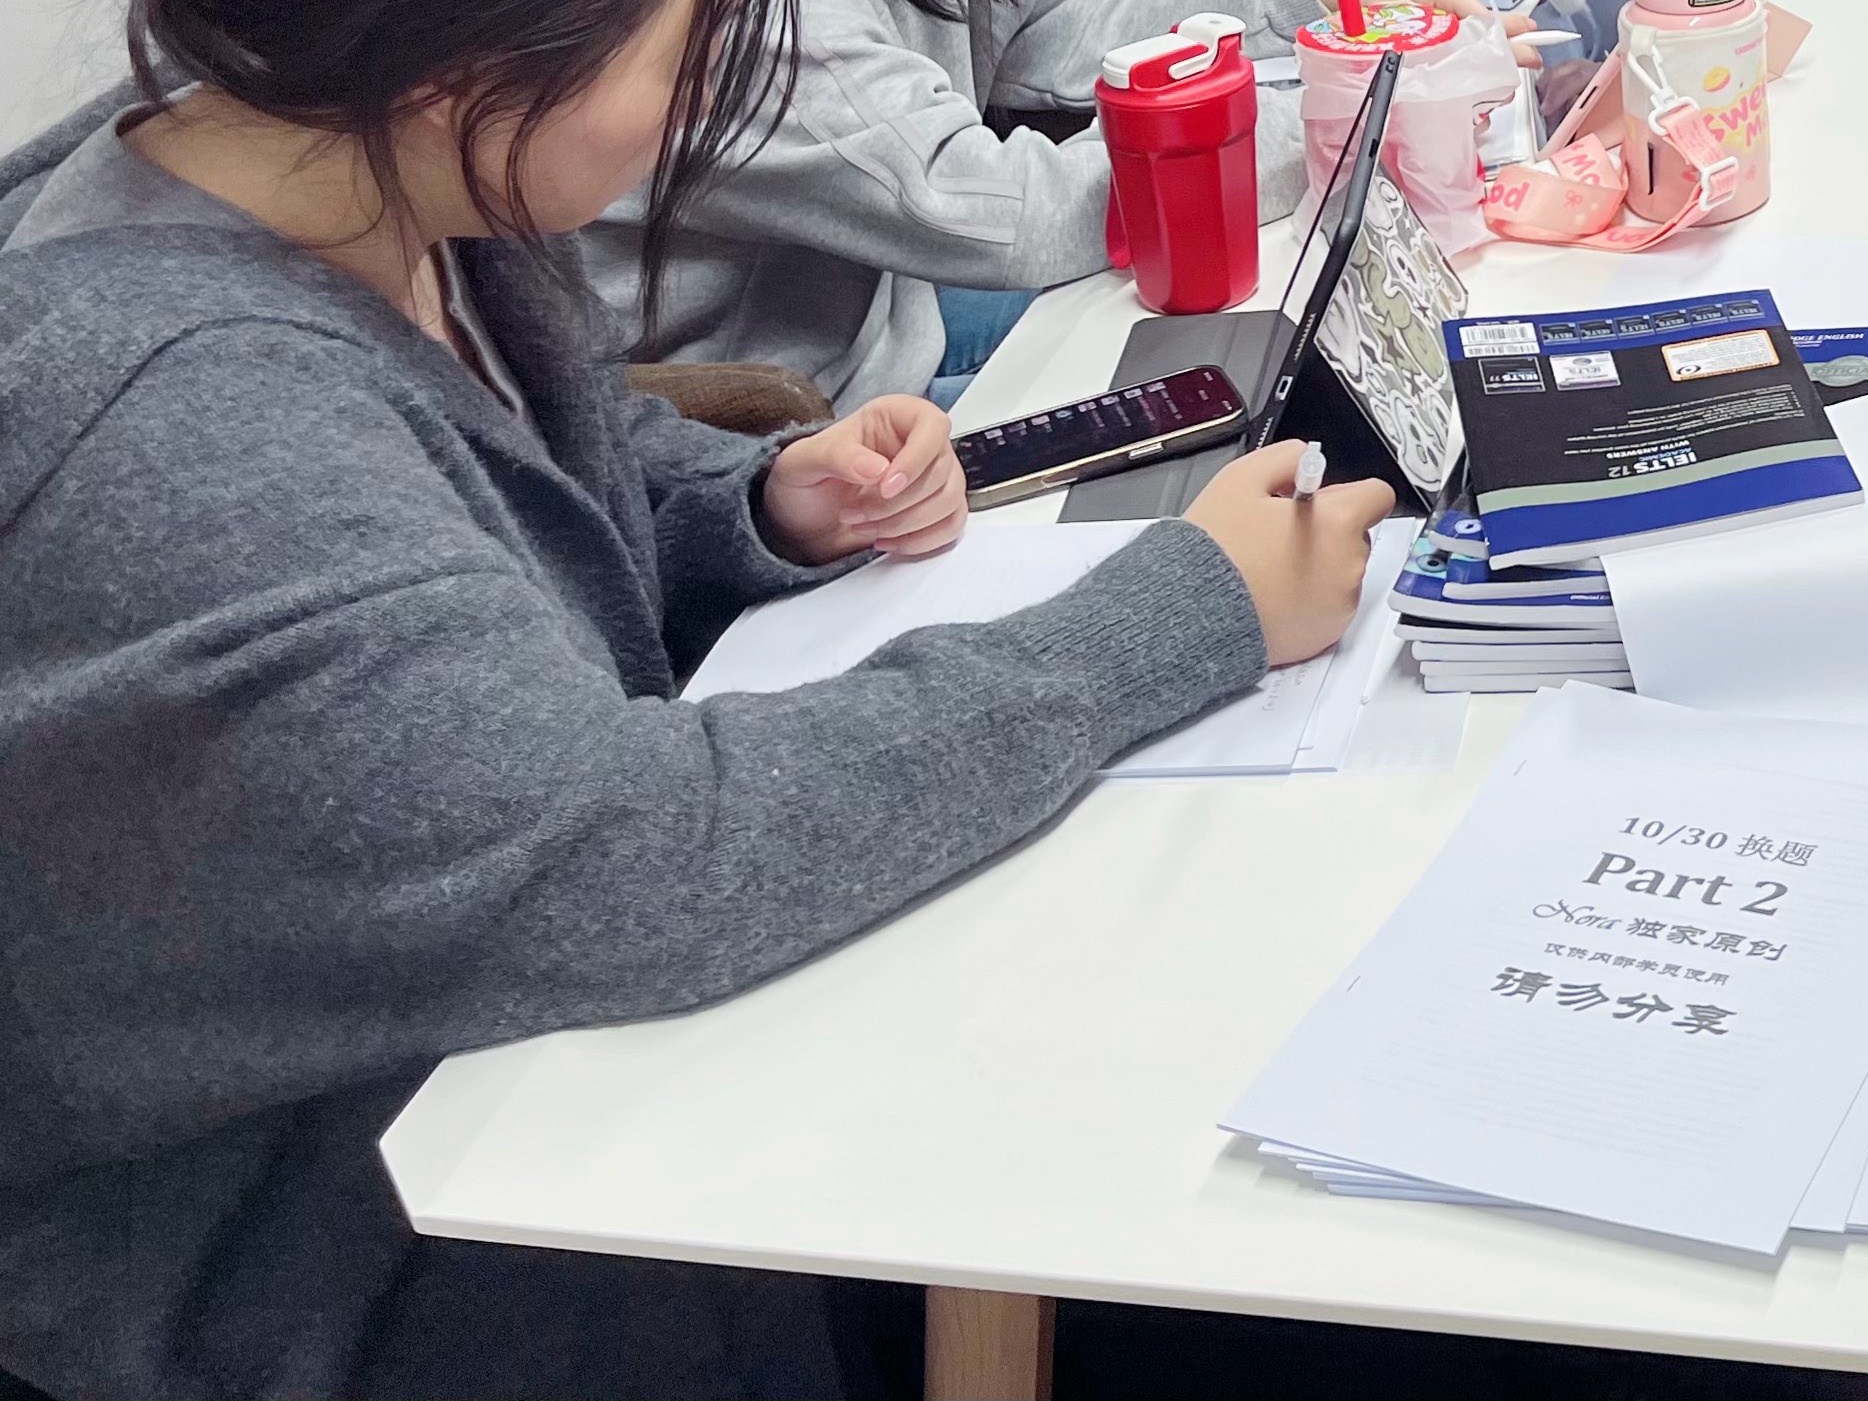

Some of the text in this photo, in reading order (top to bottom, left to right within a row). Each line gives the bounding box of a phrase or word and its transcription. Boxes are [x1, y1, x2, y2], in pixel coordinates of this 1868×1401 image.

[1501, 373, 1539, 383] IELTS
[1606, 439, 1691, 460] WITH ANSWERS
[1608, 451, 1698, 479] IELTS 12
[1638, 447, 1693, 462] ACADEMIC
[1619, 816, 1820, 867] 10/30 换题
[1582, 851, 1788, 916] Part 2
[1532, 899, 1789, 961] Nora 独家原创
[1544, 942, 1730, 987] 仅供内部学员使用
[1490, 966, 1738, 1036] 请勿分享
